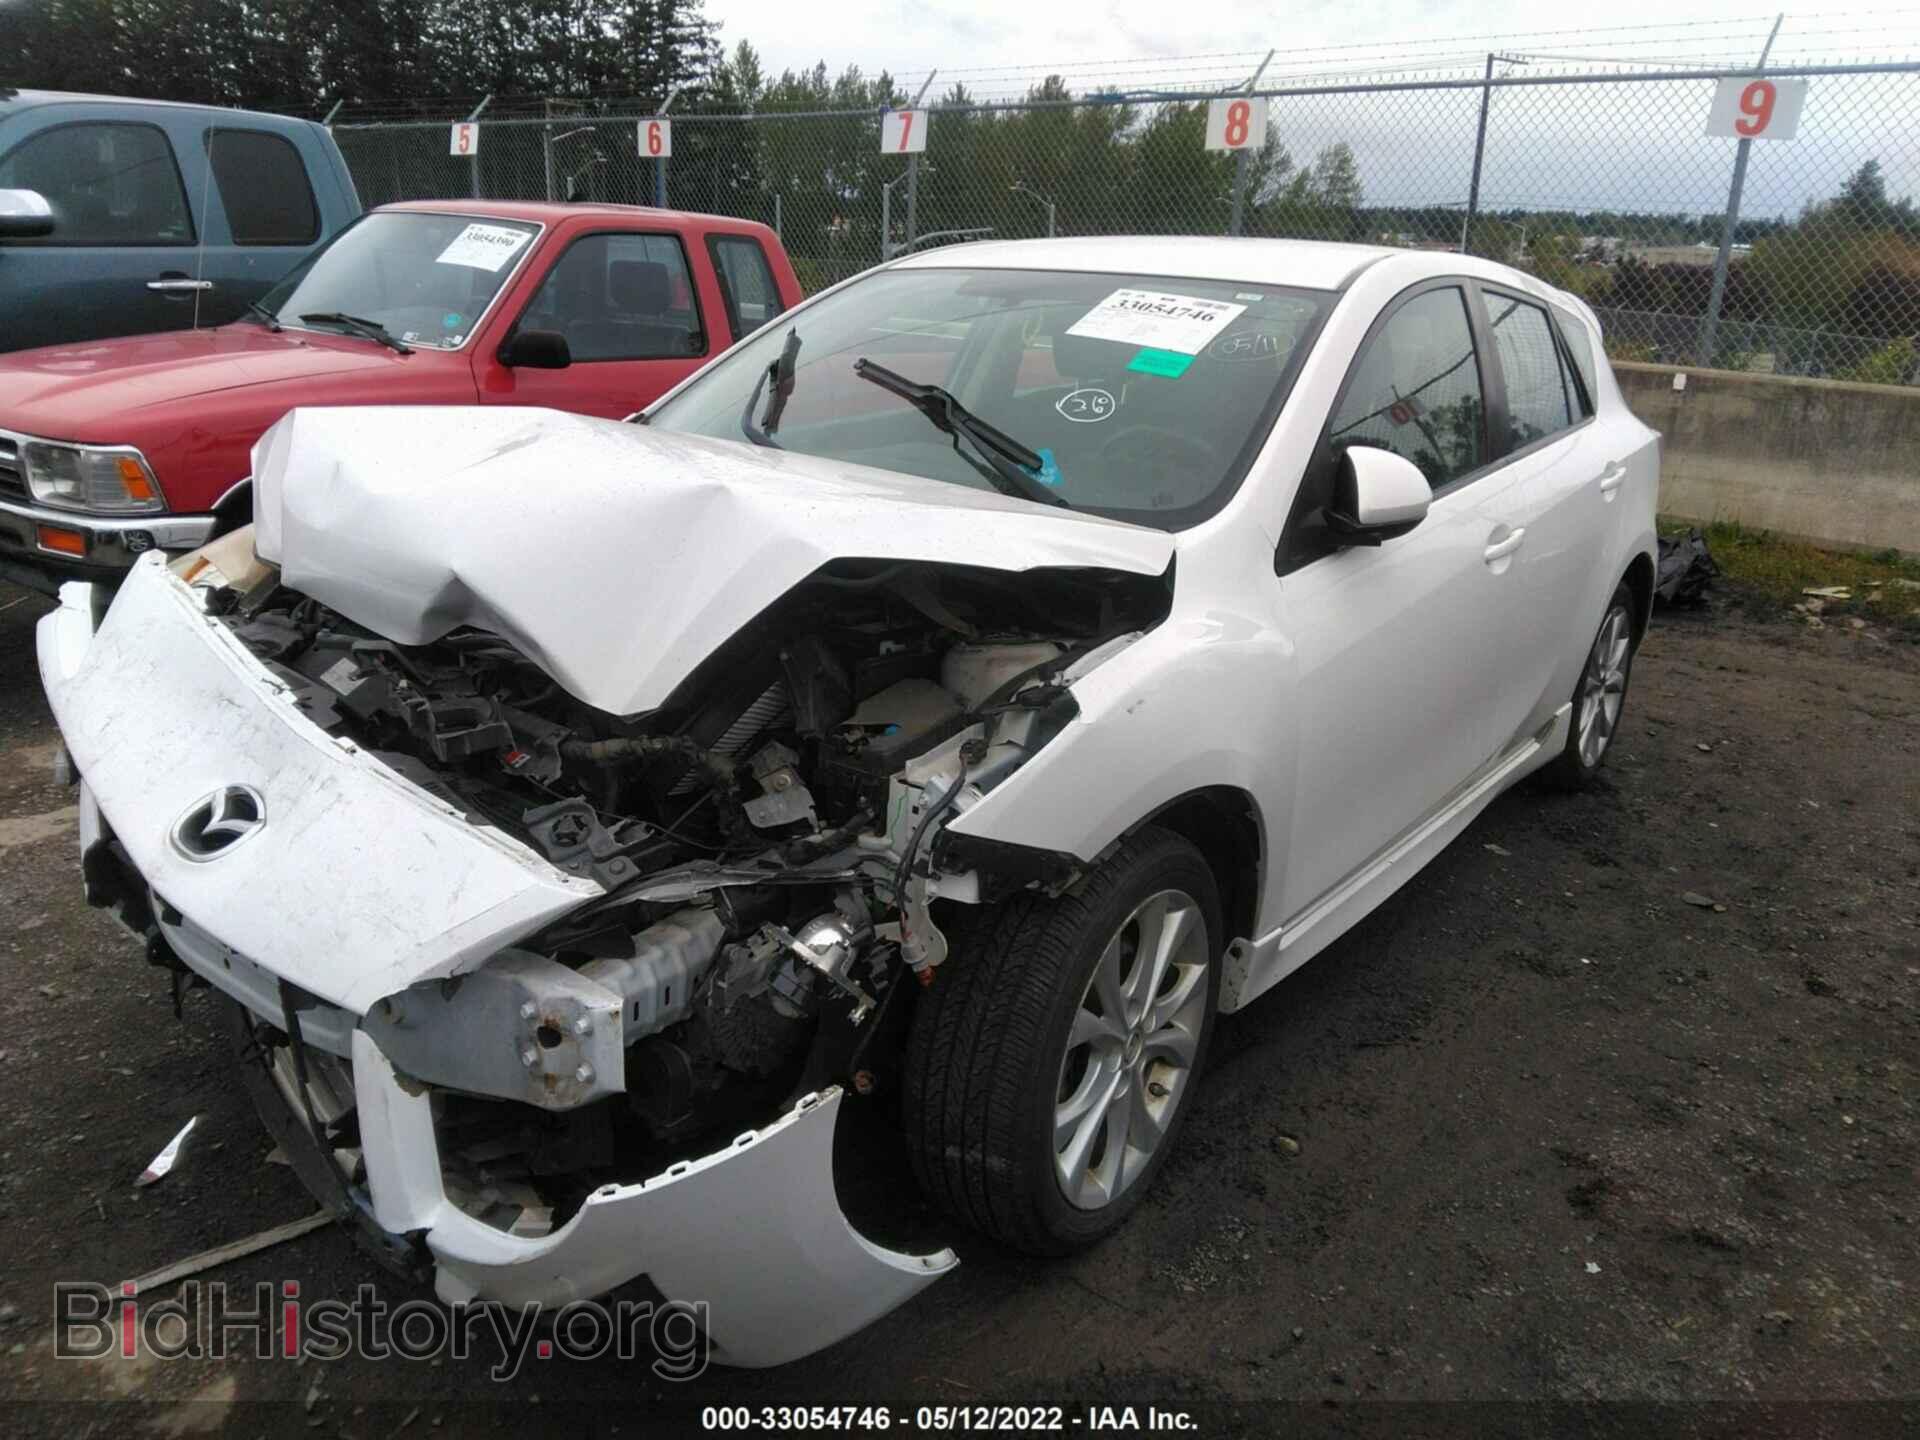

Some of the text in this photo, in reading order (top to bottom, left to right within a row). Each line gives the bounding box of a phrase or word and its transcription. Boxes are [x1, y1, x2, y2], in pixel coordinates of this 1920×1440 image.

[1224, 100, 1251, 147] 8
[1735, 80, 1777, 138] 9
[458, 124, 470, 153] 5
[647, 122, 662, 154] 6
[898, 112, 914, 150] 7
[1111, 299, 1215, 322] 33054746
